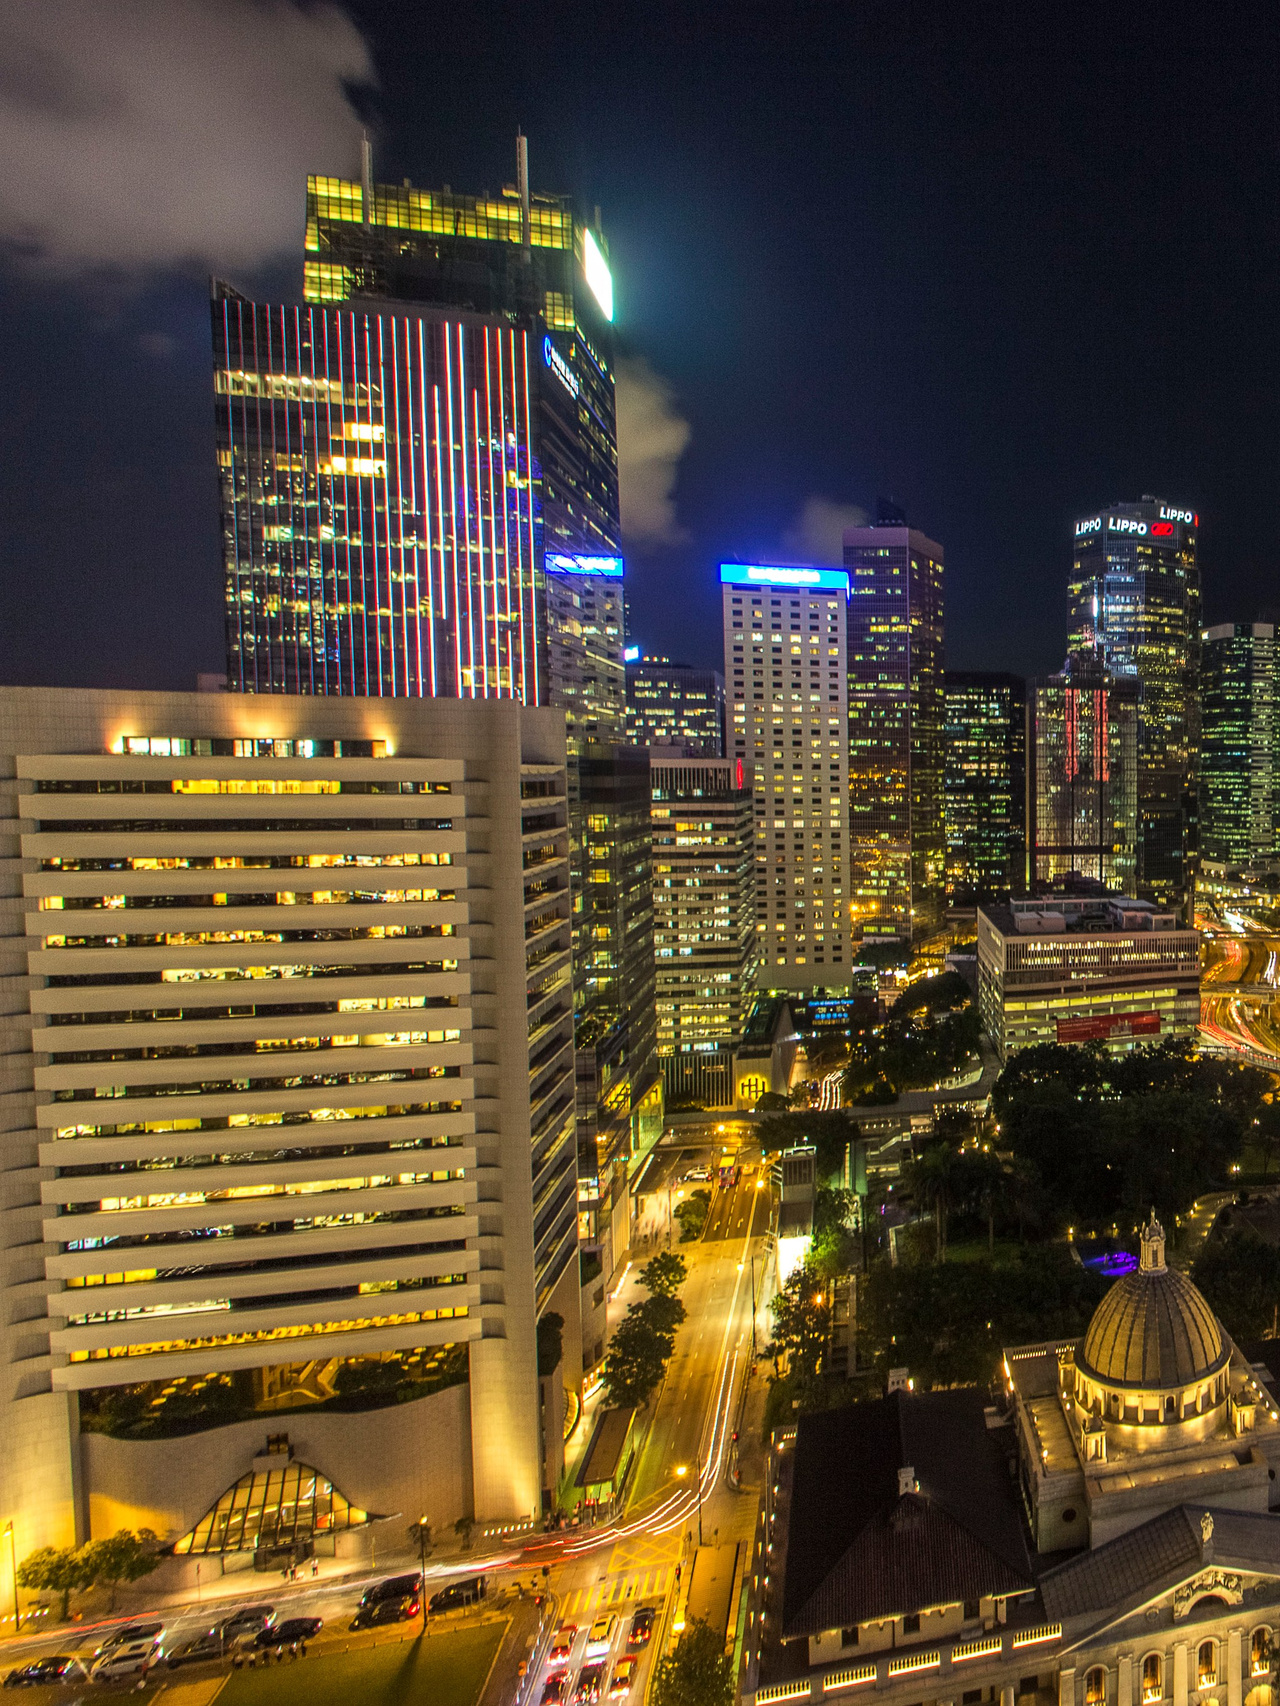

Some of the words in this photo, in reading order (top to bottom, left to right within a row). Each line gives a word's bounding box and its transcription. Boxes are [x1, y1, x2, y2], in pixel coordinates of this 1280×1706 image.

[1160, 506, 1193, 524] LIPPO
[1075, 517, 1102, 536] LIPPO
[1108, 517, 1148, 536] LIPPO
